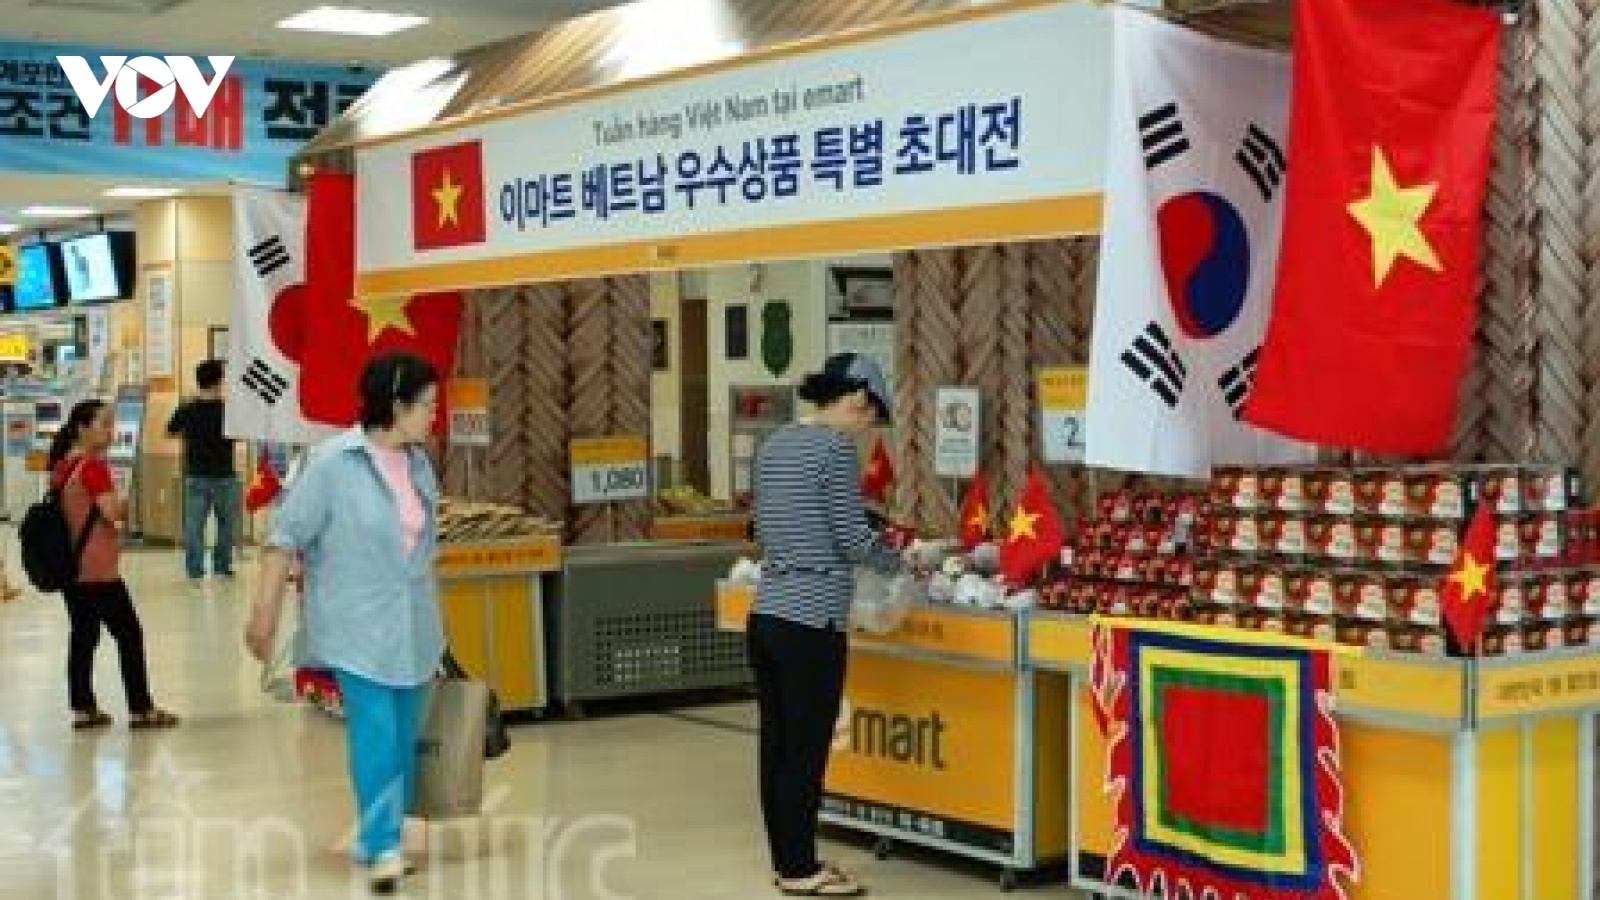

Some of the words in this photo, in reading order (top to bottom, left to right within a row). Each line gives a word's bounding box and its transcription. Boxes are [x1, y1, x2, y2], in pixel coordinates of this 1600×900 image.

[724, 95, 768, 122] Nam
[803, 75, 863, 111] emart
[500, 173, 575, 231] 이마트
[582, 153, 668, 221] 베트남
[675, 133, 801, 210] 우수상품
[811, 117, 883, 192] 특별
[893, 96, 1021, 175] 초대전
